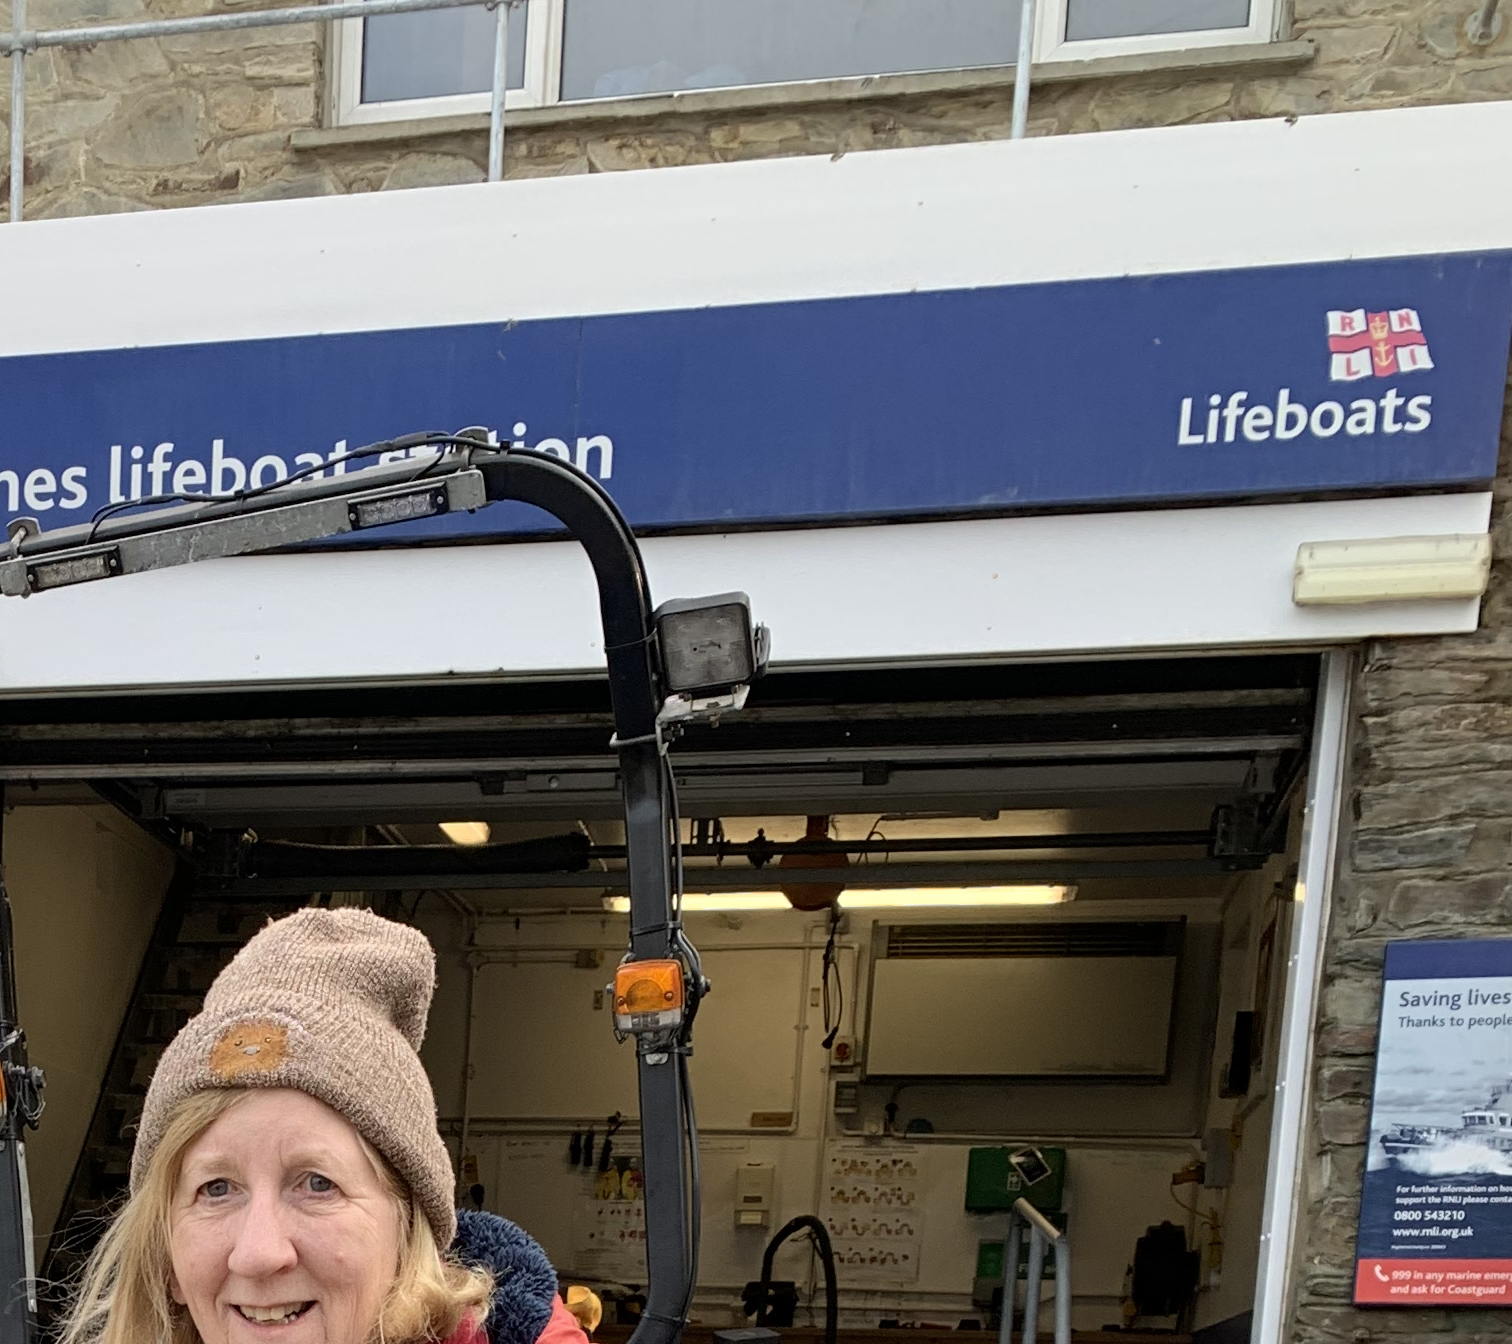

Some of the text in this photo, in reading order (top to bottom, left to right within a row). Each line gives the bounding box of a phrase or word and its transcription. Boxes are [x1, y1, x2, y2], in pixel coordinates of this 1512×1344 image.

[1177, 388, 1433, 446] Lifeboats
[108, 437, 348, 501] lifeboat
[1399, 988, 1512, 1011] Saving lives
[1399, 1015, 1446, 1028] Thanks
[1450, 1016, 1465, 1027] to
[1396, 1185, 1410, 1194] For
[1411, 1185, 1439, 1194] further
[1440, 1185, 1487, 1193] information
[1395, 1196, 1427, 1206] support
[1428, 1196, 1442, 1204] the
[1463, 1197, 1488, 1205] please
[1394, 1210, 1466, 1221] 0800 543210
[1392, 1226, 1474, 1239] www.rnli.org.uk
[1391, 1270, 1412, 1280] 999
[1413, 1270, 1424, 1280] in
[1425, 1271, 1445, 1283] any
[1446, 1270, 1482, 1280] marine
[1390, 1284, 1507, 1297] and ask for Coastguard
